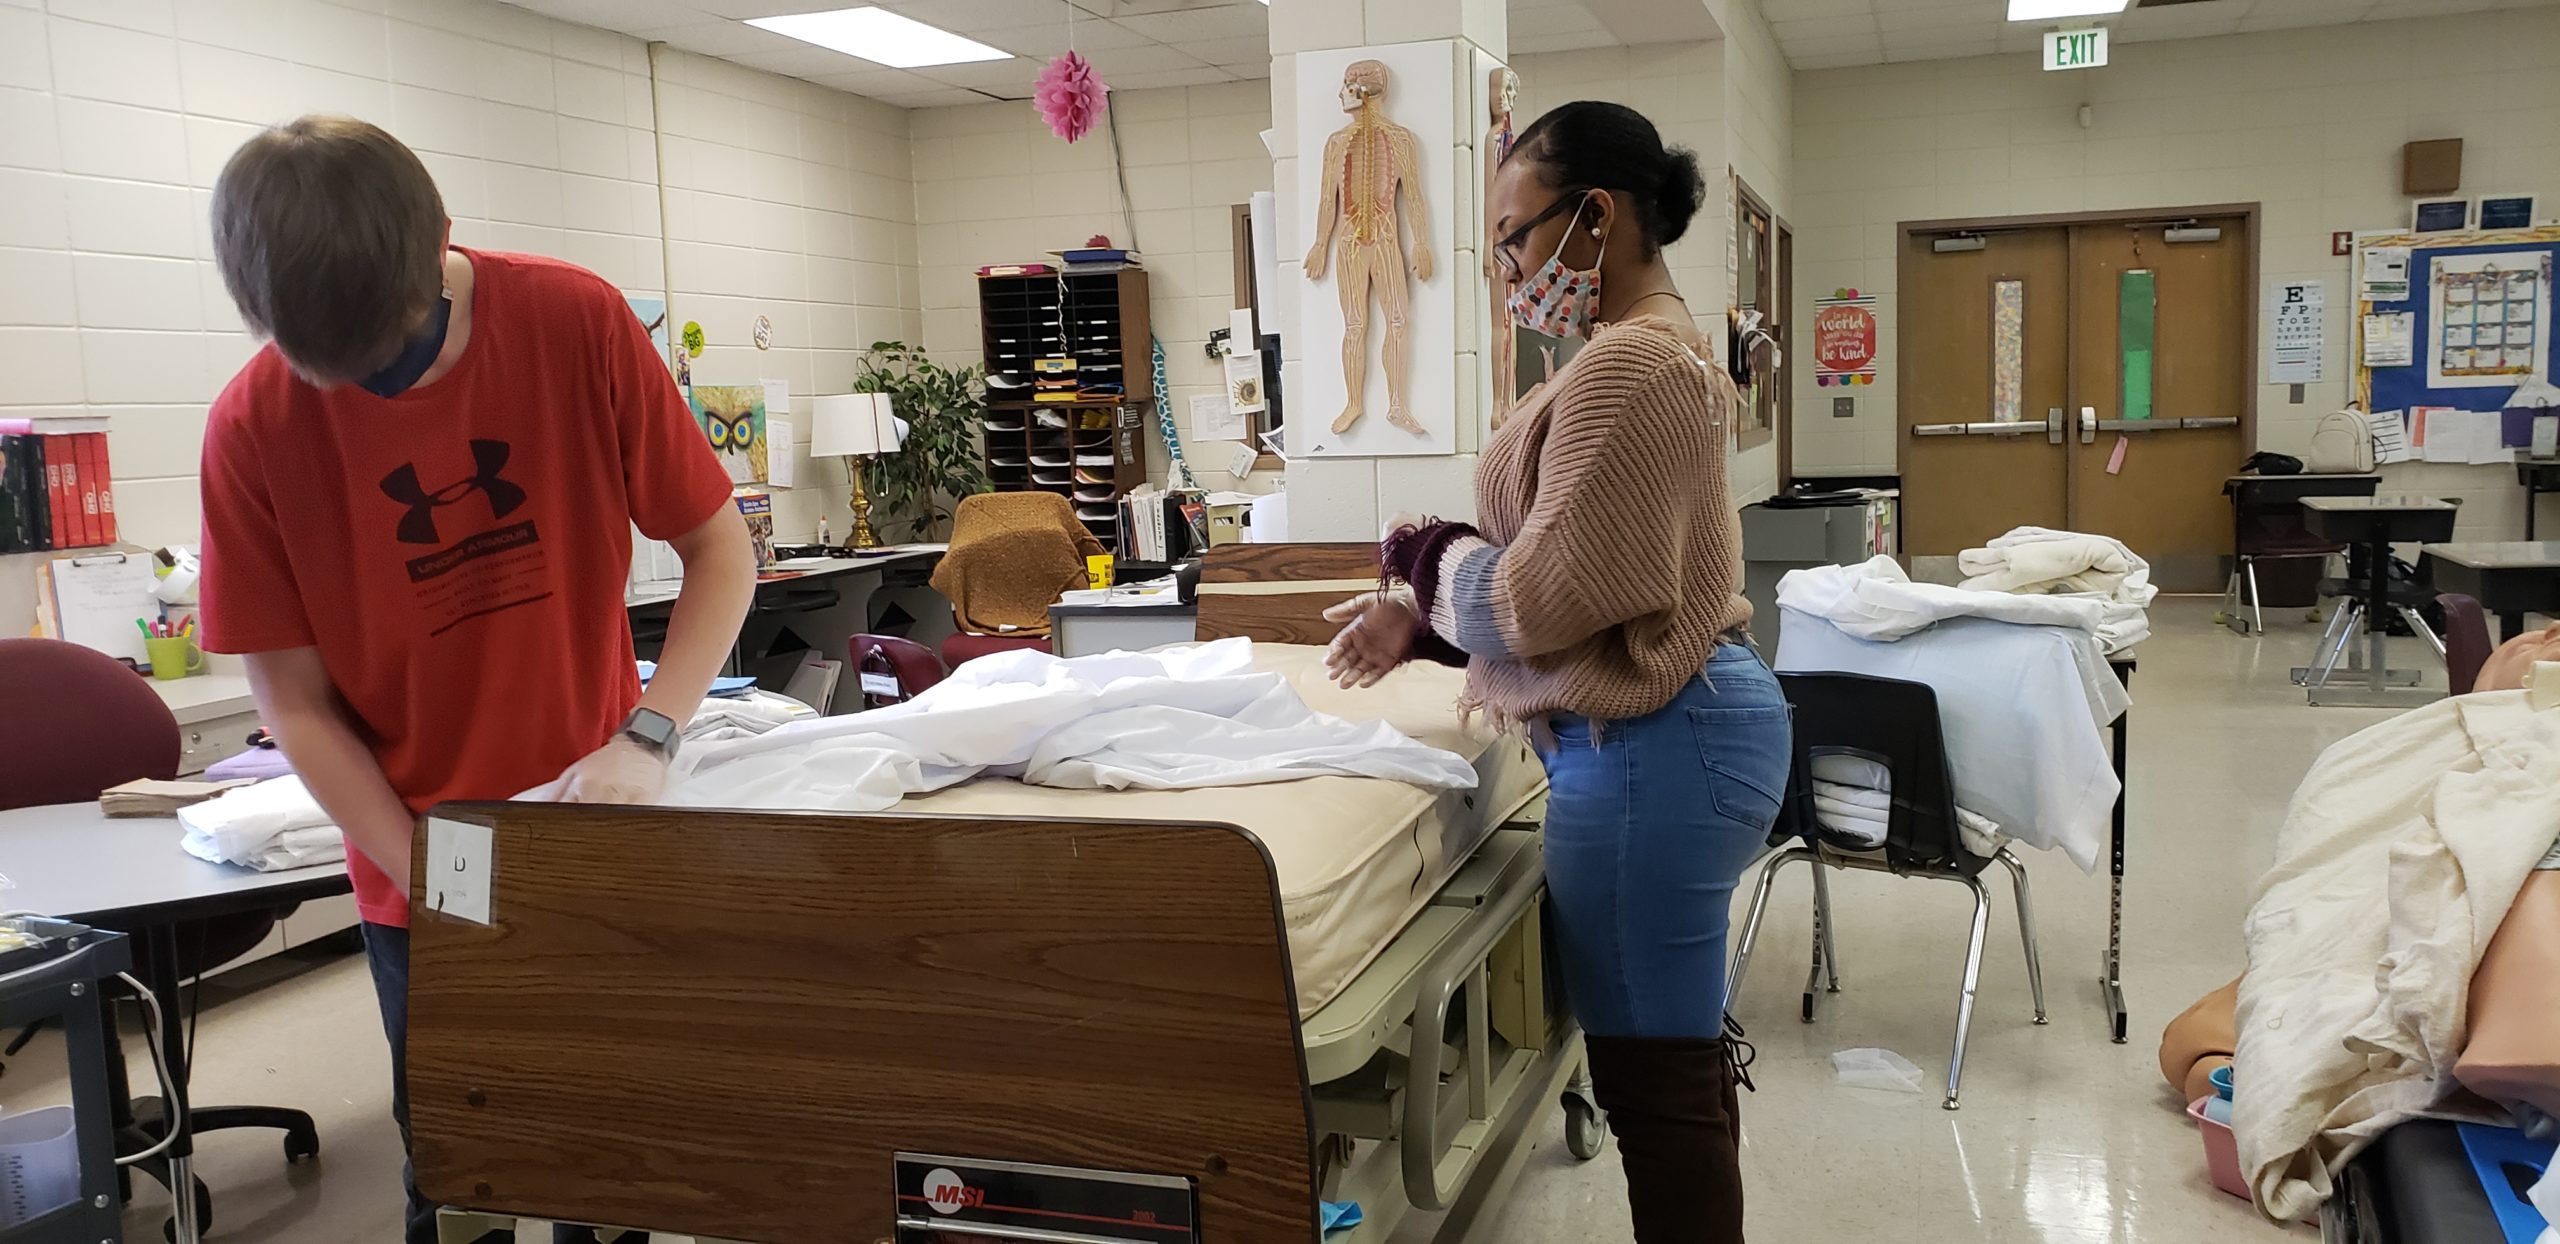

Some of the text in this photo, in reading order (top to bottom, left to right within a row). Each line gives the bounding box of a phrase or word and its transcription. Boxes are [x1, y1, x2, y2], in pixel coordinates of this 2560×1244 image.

[2057, 32, 2098, 66] EXIT
[2285, 286, 2303, 303] E
[1821, 313, 1865, 331] world
[1822, 345, 1836, 361] be
[416, 548, 464, 575] UNDER
[466, 528, 529, 554] ARMOUR
[934, 1184, 985, 1208] MSI
